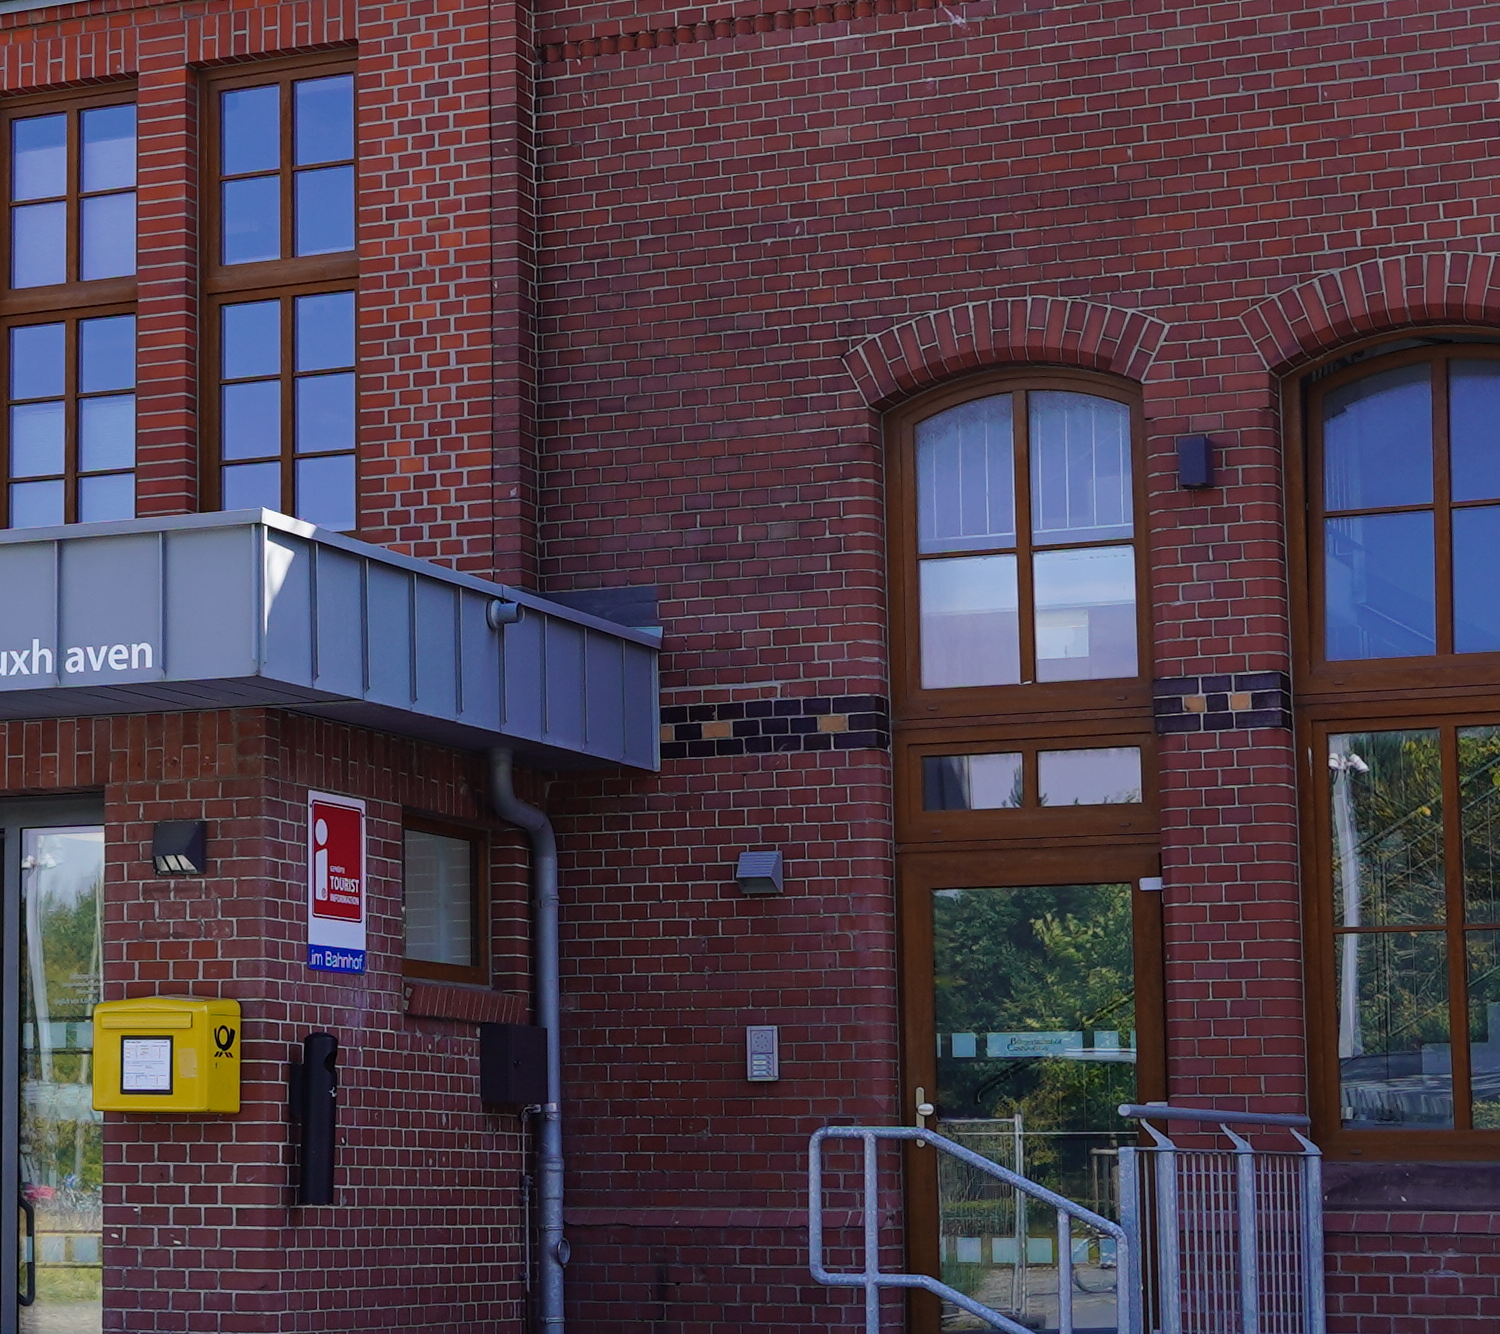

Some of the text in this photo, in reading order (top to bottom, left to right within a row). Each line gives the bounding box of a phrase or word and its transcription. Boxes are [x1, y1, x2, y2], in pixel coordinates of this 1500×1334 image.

[329, 875, 360, 894] TOURIST
[311, 948, 363, 970] im Bahnhof
